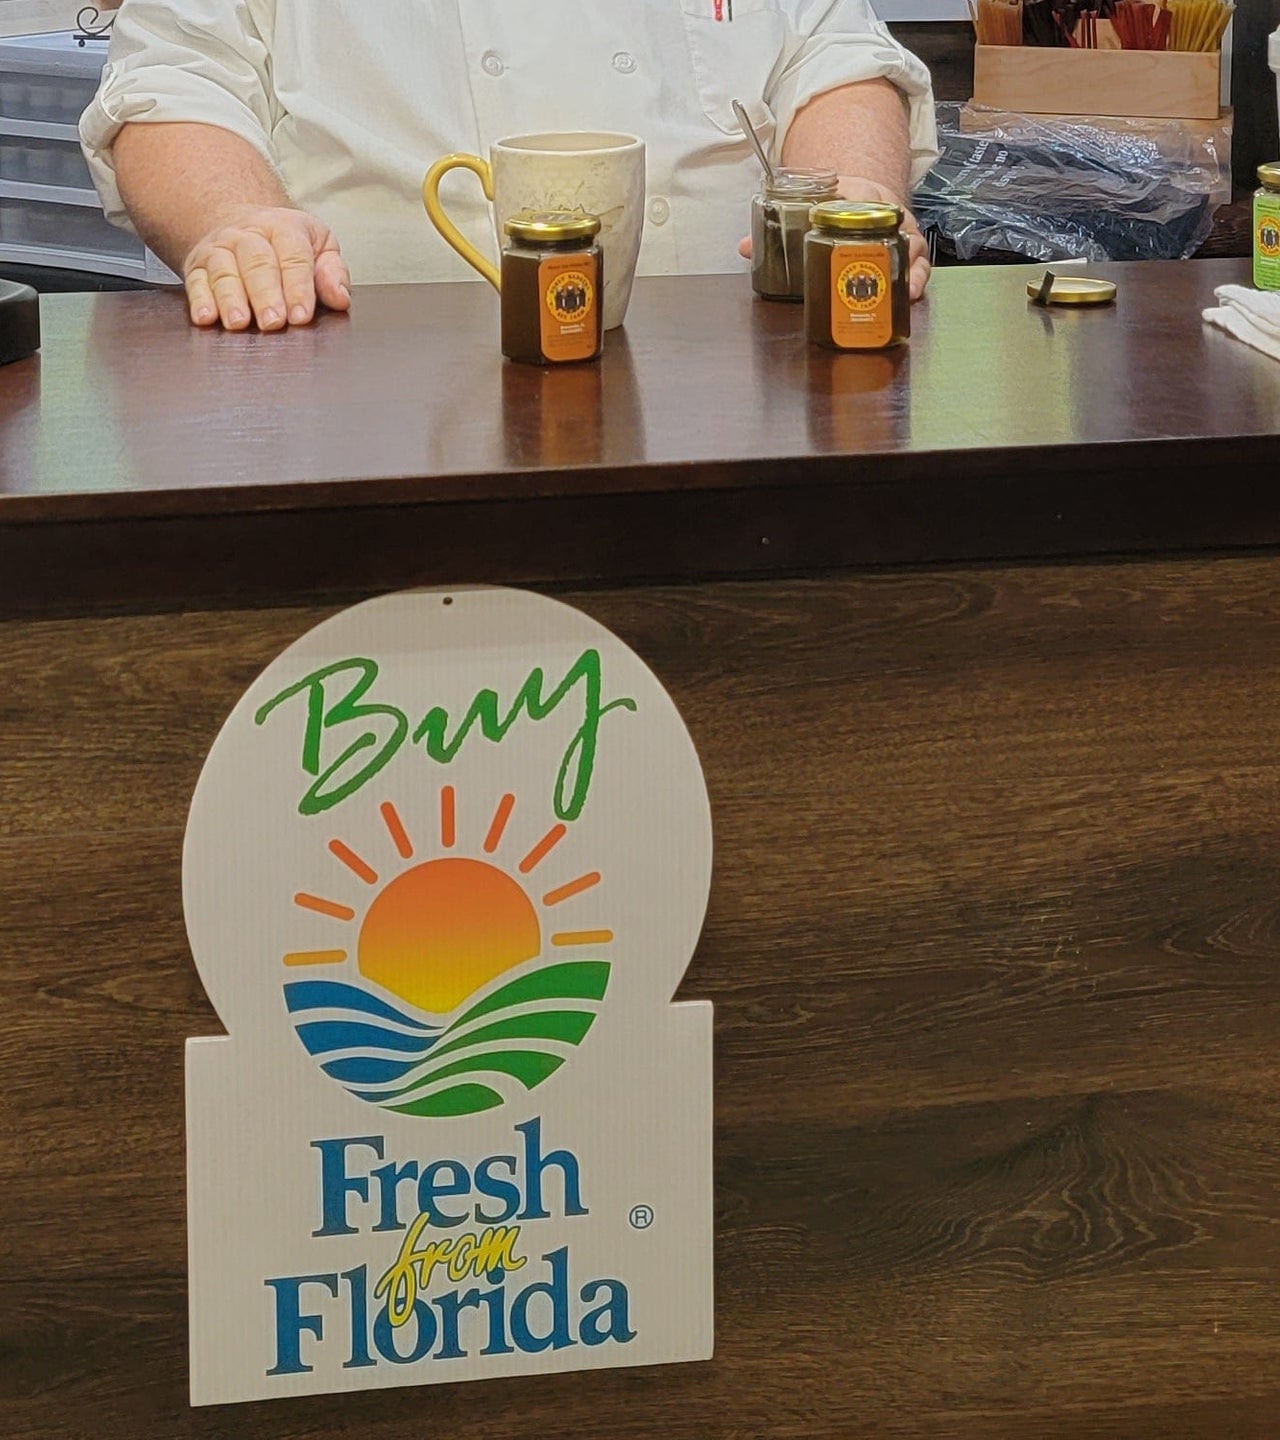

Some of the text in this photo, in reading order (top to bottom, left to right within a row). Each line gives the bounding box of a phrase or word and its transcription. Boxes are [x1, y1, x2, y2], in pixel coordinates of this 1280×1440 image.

[254, 647, 637, 822] Buy
[310, 1115, 589, 1239] Fresh
[264, 1245, 638, 1376] Florida
[373, 1210, 528, 1328] from
